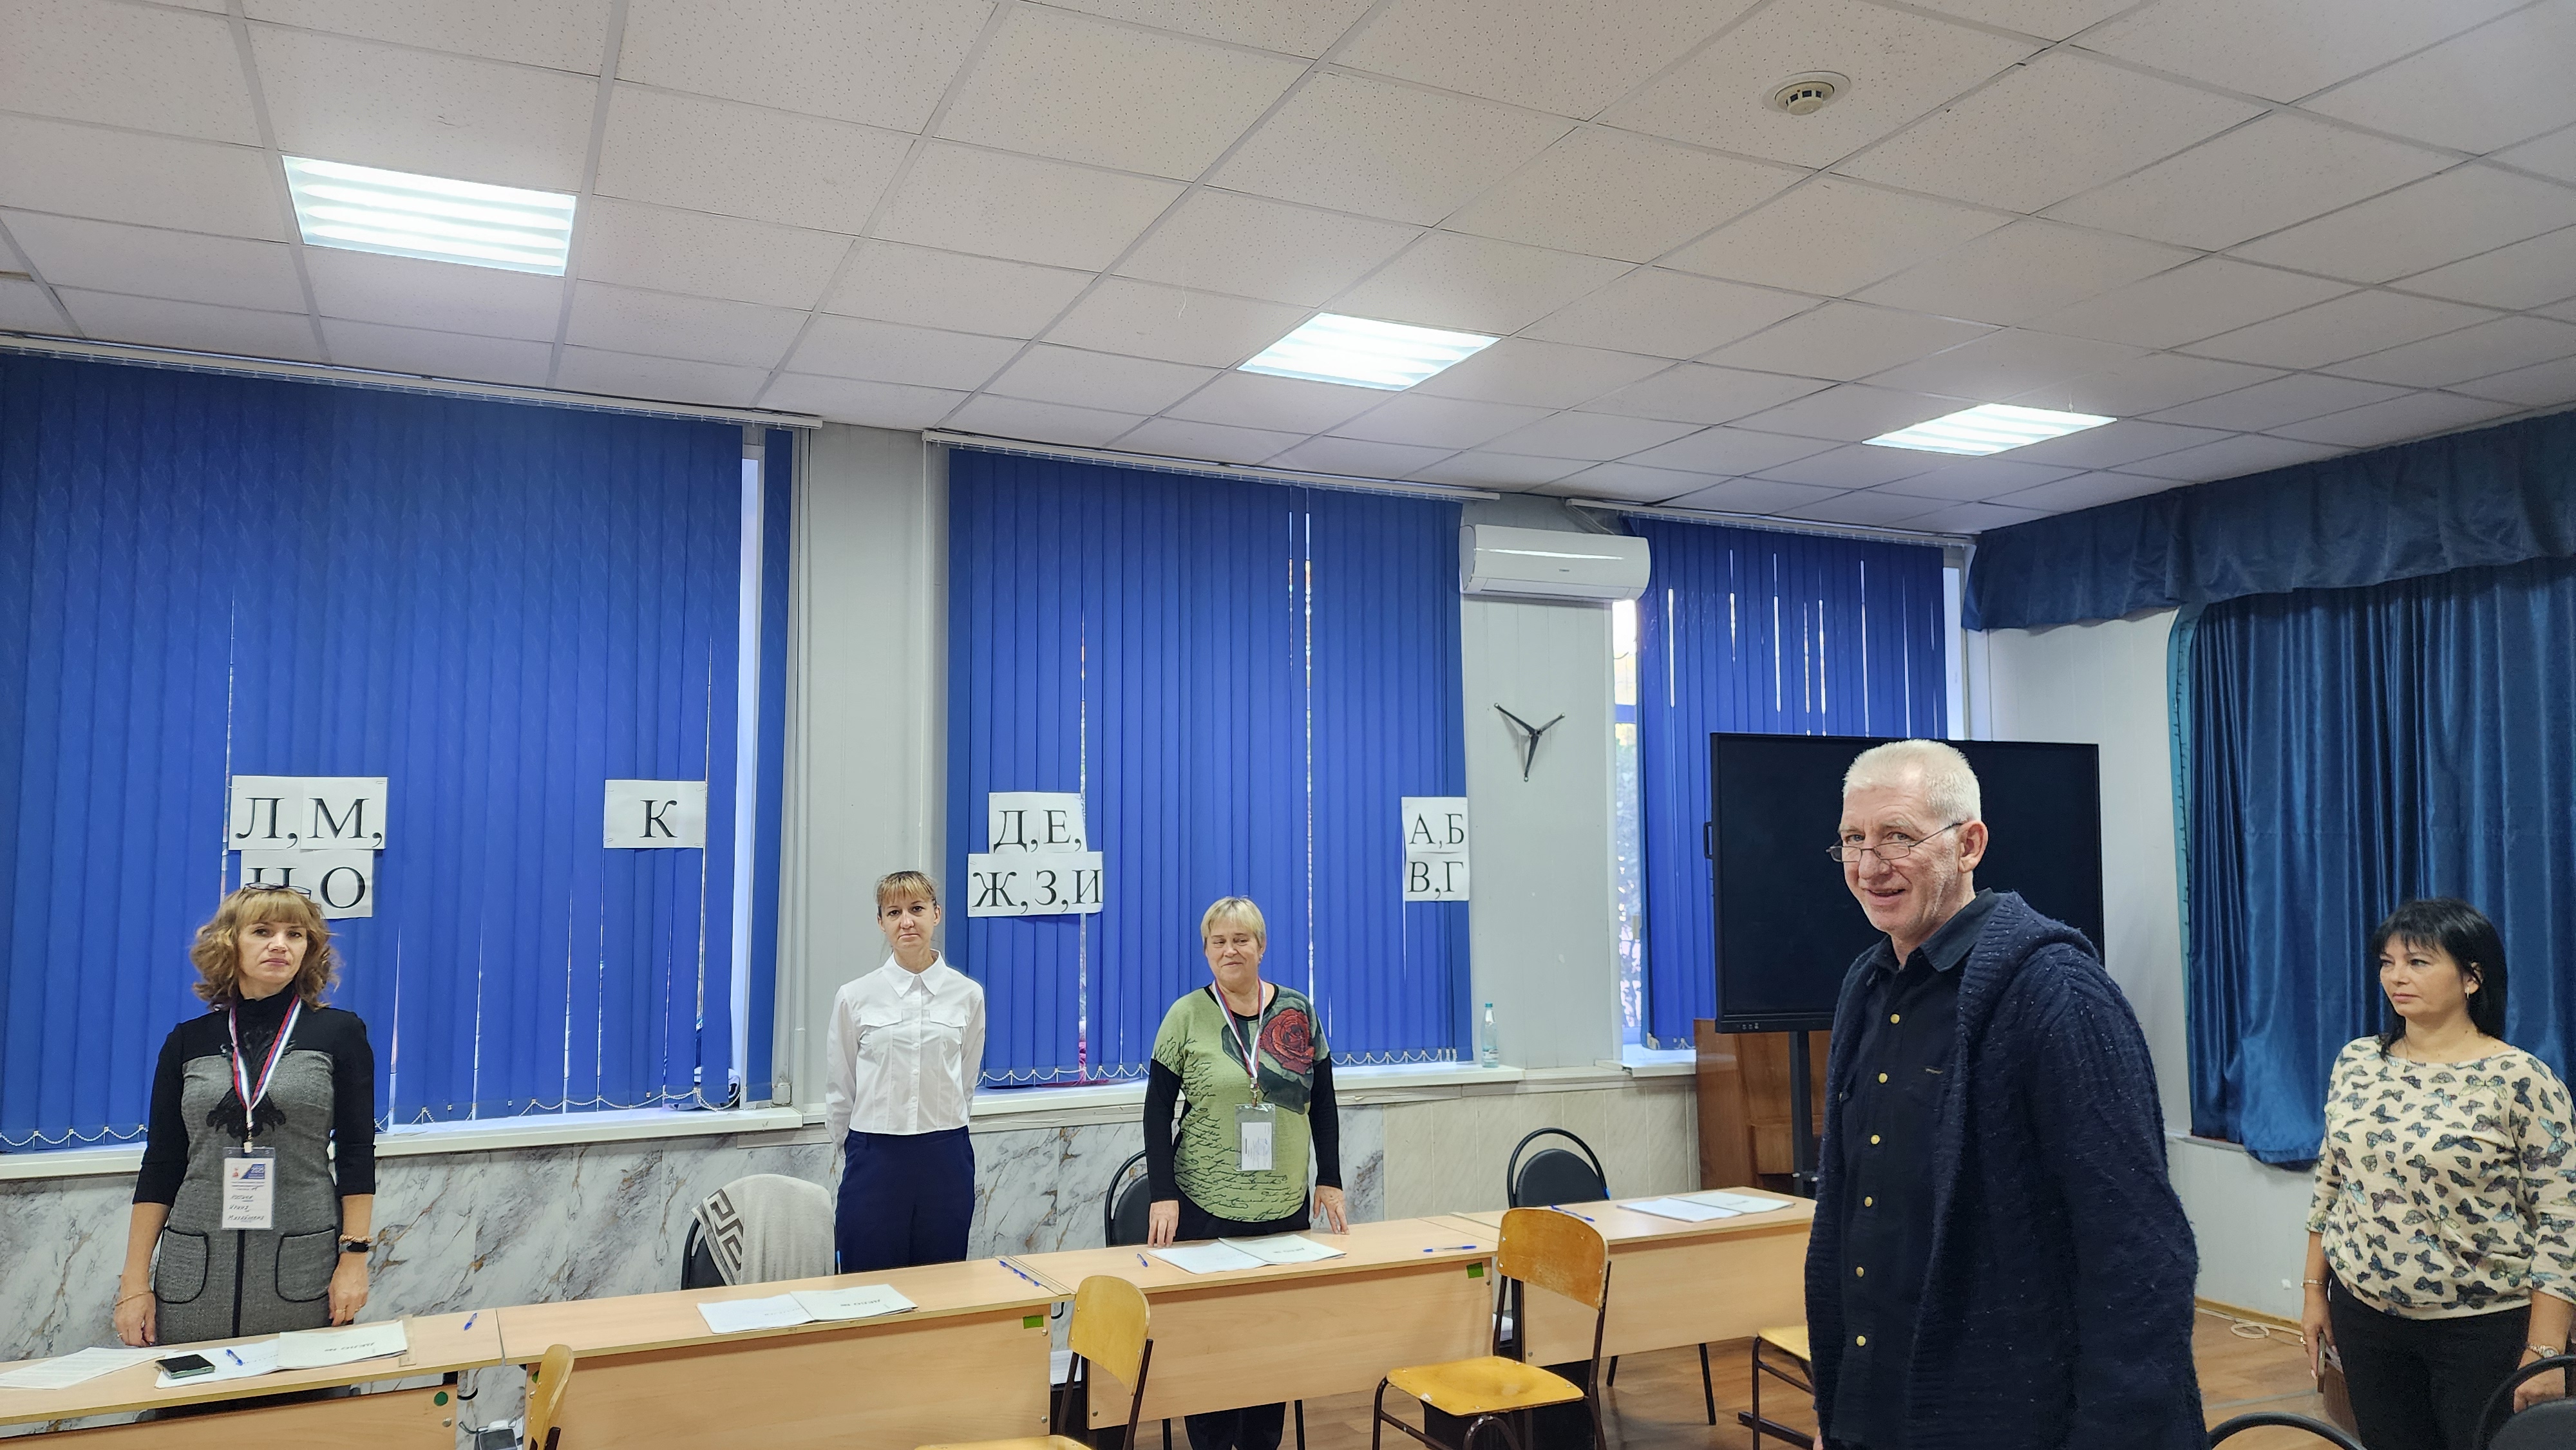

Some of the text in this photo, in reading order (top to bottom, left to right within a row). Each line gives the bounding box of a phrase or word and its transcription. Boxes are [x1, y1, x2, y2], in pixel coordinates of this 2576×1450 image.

[235, 797, 383, 849] Л,М,
[639, 800, 678, 838] К
[993, 809, 1082, 853] Д,Е,
[1408, 813, 1464, 849] А,Б
[972, 869, 1103, 915] Ж,З,И
[1407, 861, 1464, 899] В,Г
